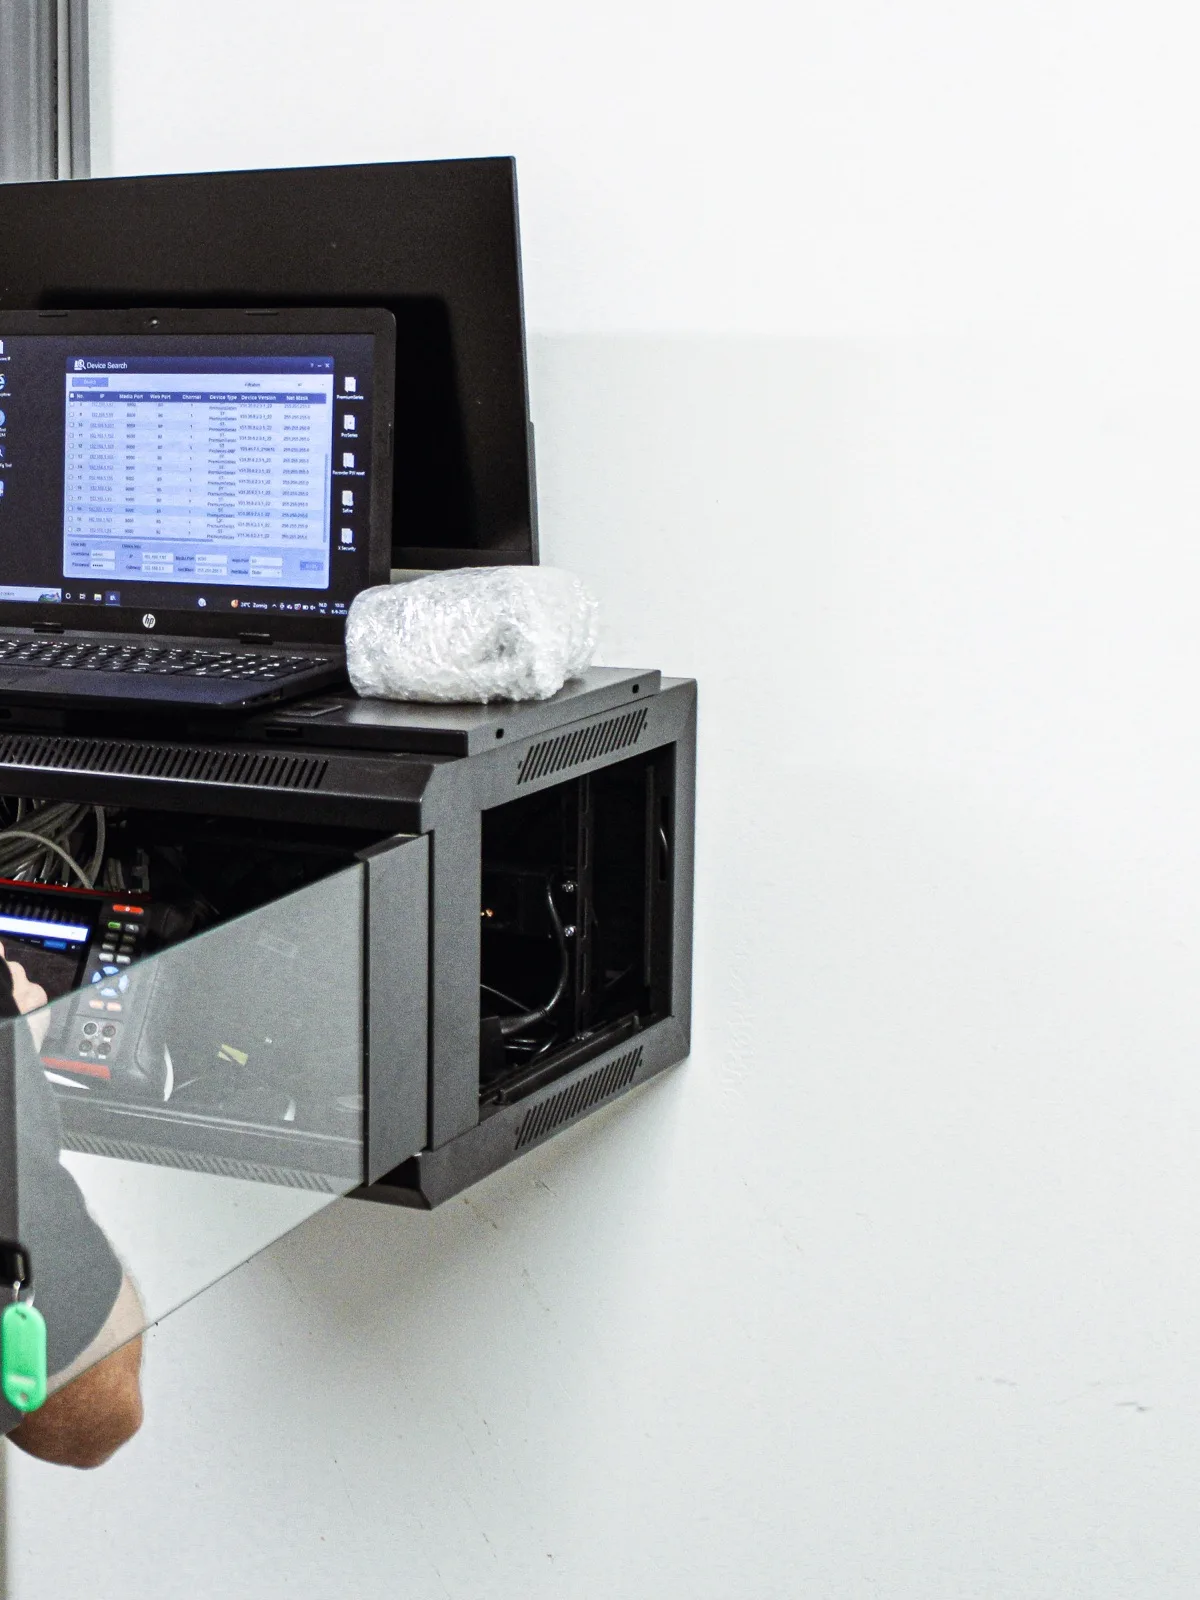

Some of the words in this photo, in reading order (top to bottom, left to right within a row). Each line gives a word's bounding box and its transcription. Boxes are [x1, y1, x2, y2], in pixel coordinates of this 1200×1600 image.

[86, 361, 106, 369] Device
[107, 361, 128, 370] Search
[143, 613, 156, 629] hp
